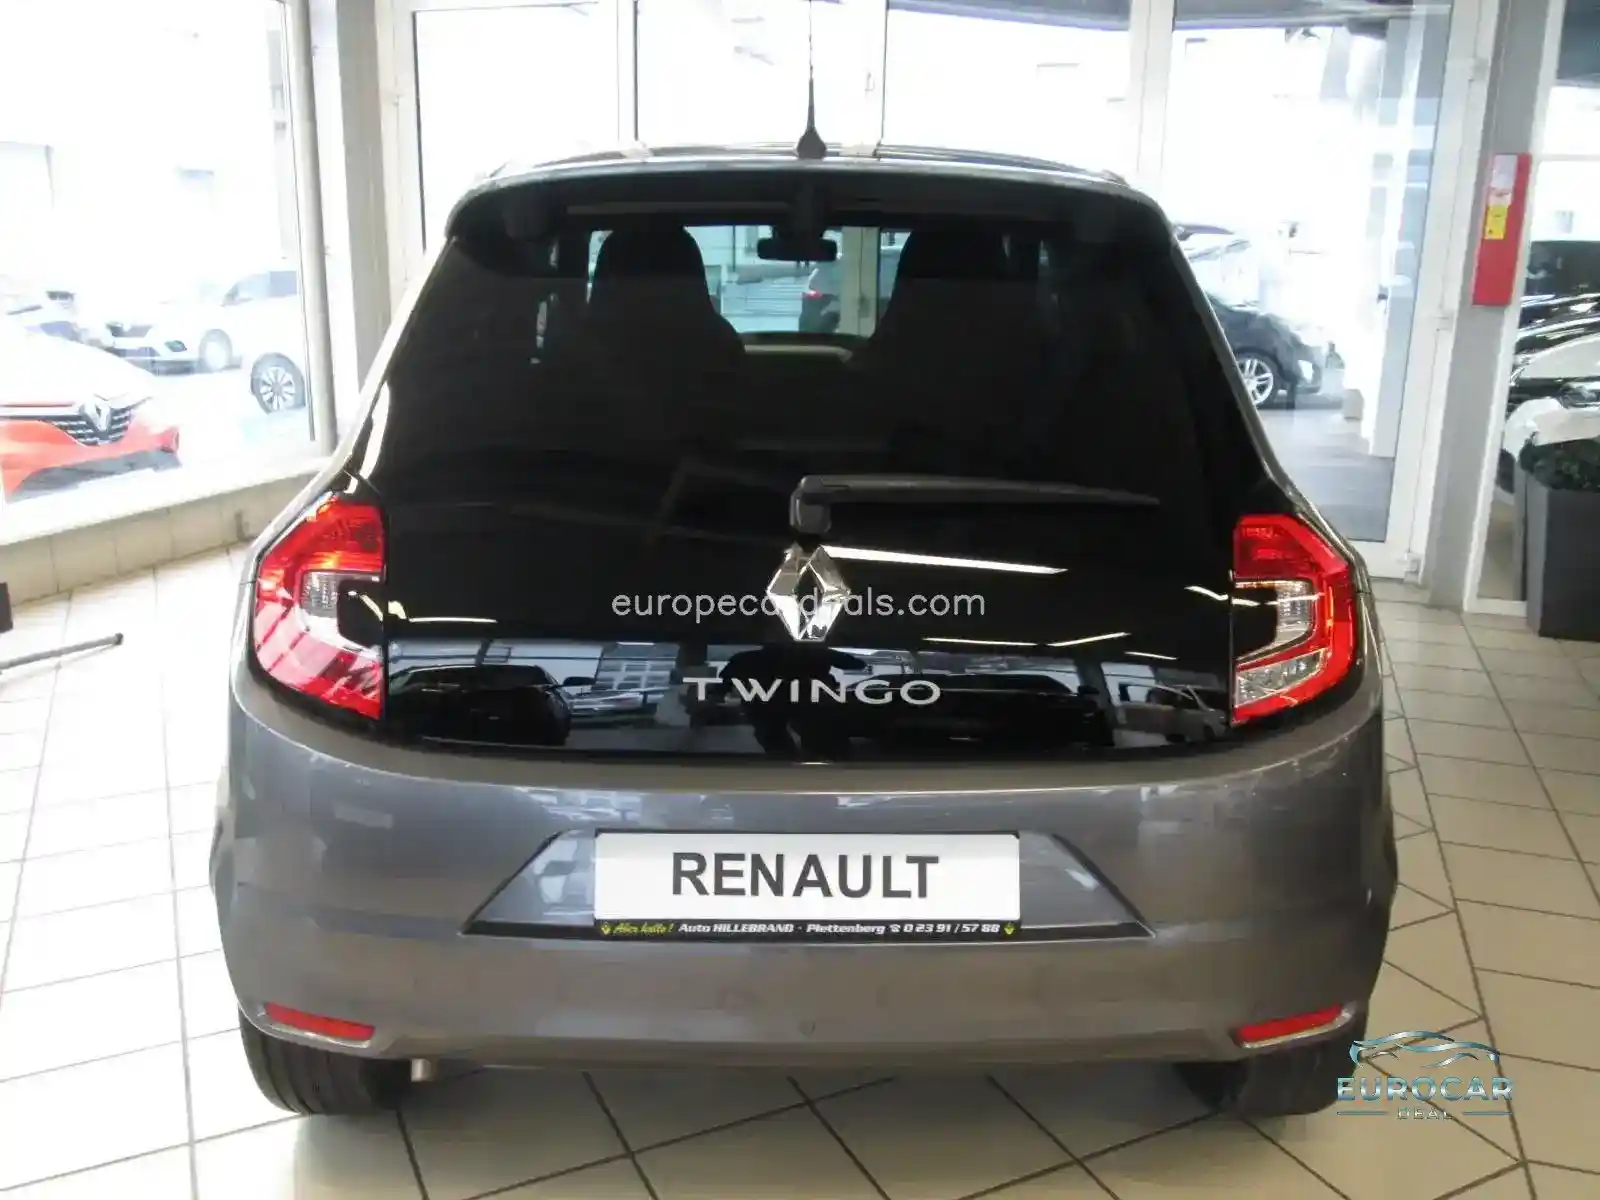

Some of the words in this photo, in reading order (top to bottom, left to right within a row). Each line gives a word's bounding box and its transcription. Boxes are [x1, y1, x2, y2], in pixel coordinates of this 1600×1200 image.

[682, 677, 942, 706] TWINGO
[672, 851, 939, 898] RENAULT
[678, 923, 710, 933] Auto
[713, 923, 794, 933] HILLEBRAND
[806, 923, 885, 935] Plettenberg
